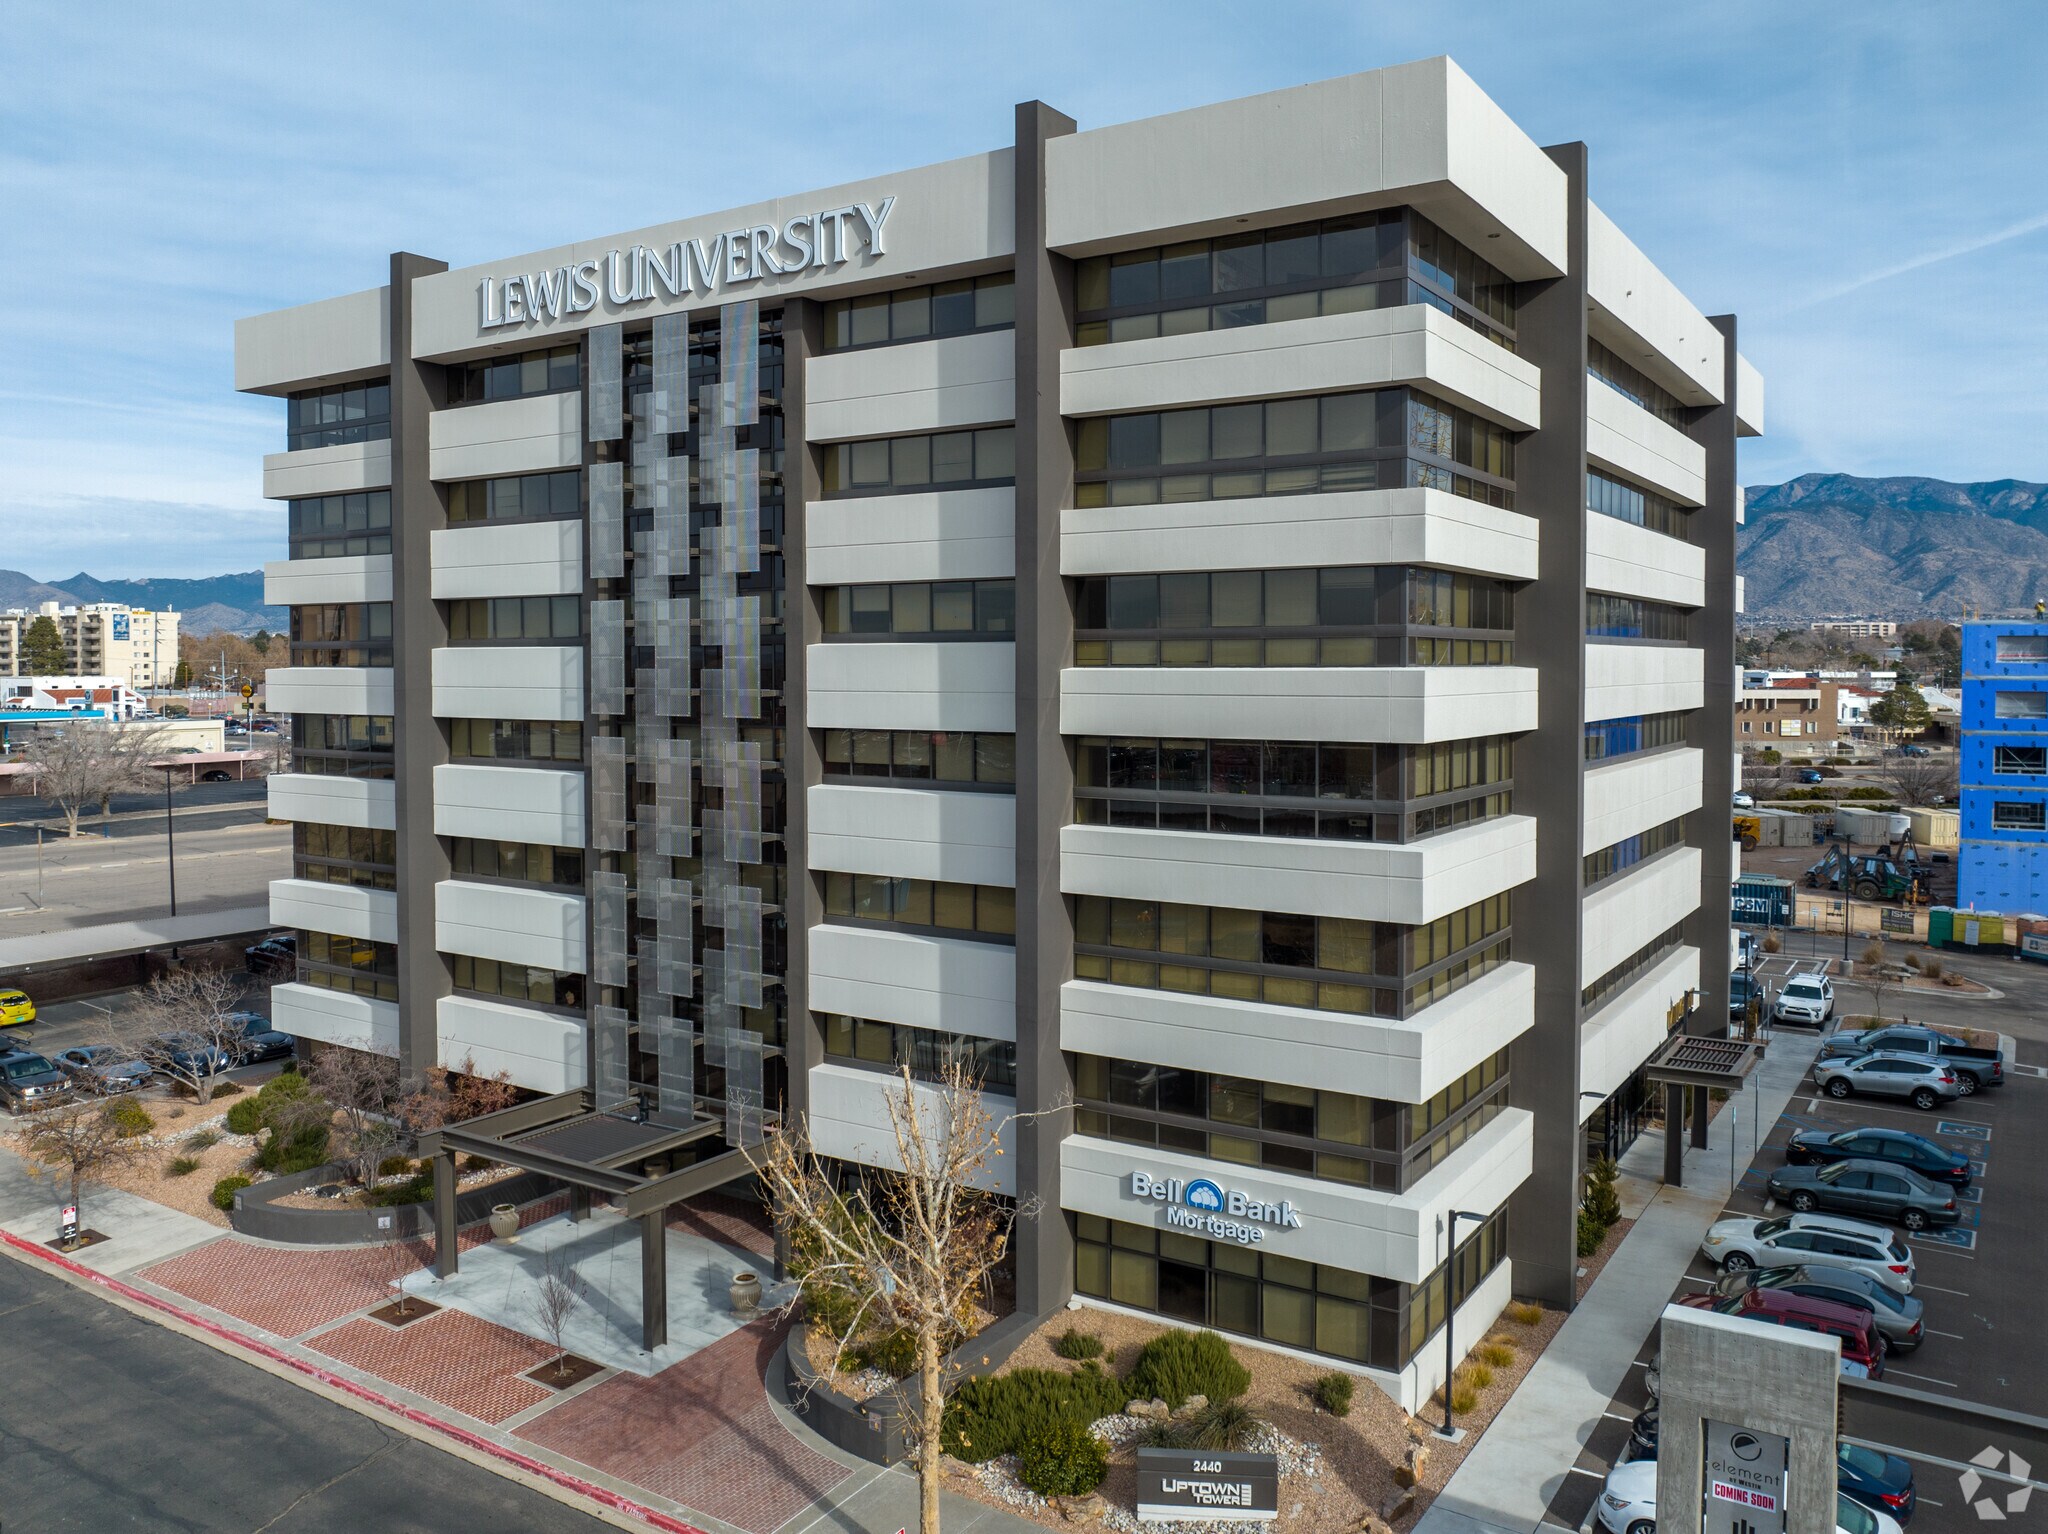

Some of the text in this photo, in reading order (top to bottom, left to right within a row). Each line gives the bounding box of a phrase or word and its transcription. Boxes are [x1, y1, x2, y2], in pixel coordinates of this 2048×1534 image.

[480, 196, 898, 329] LEWIS UNIVERSITY
[1132, 1171, 1302, 1229] Bell Bank
[1167, 1206, 1264, 1244] Mortgage
[1193, 1460, 1222, 1473] 2440
[1712, 1459, 1780, 1486] element
[1162, 1478, 1240, 1496] UPTOWN
[1714, 1483, 1774, 1511] COMING SOON
